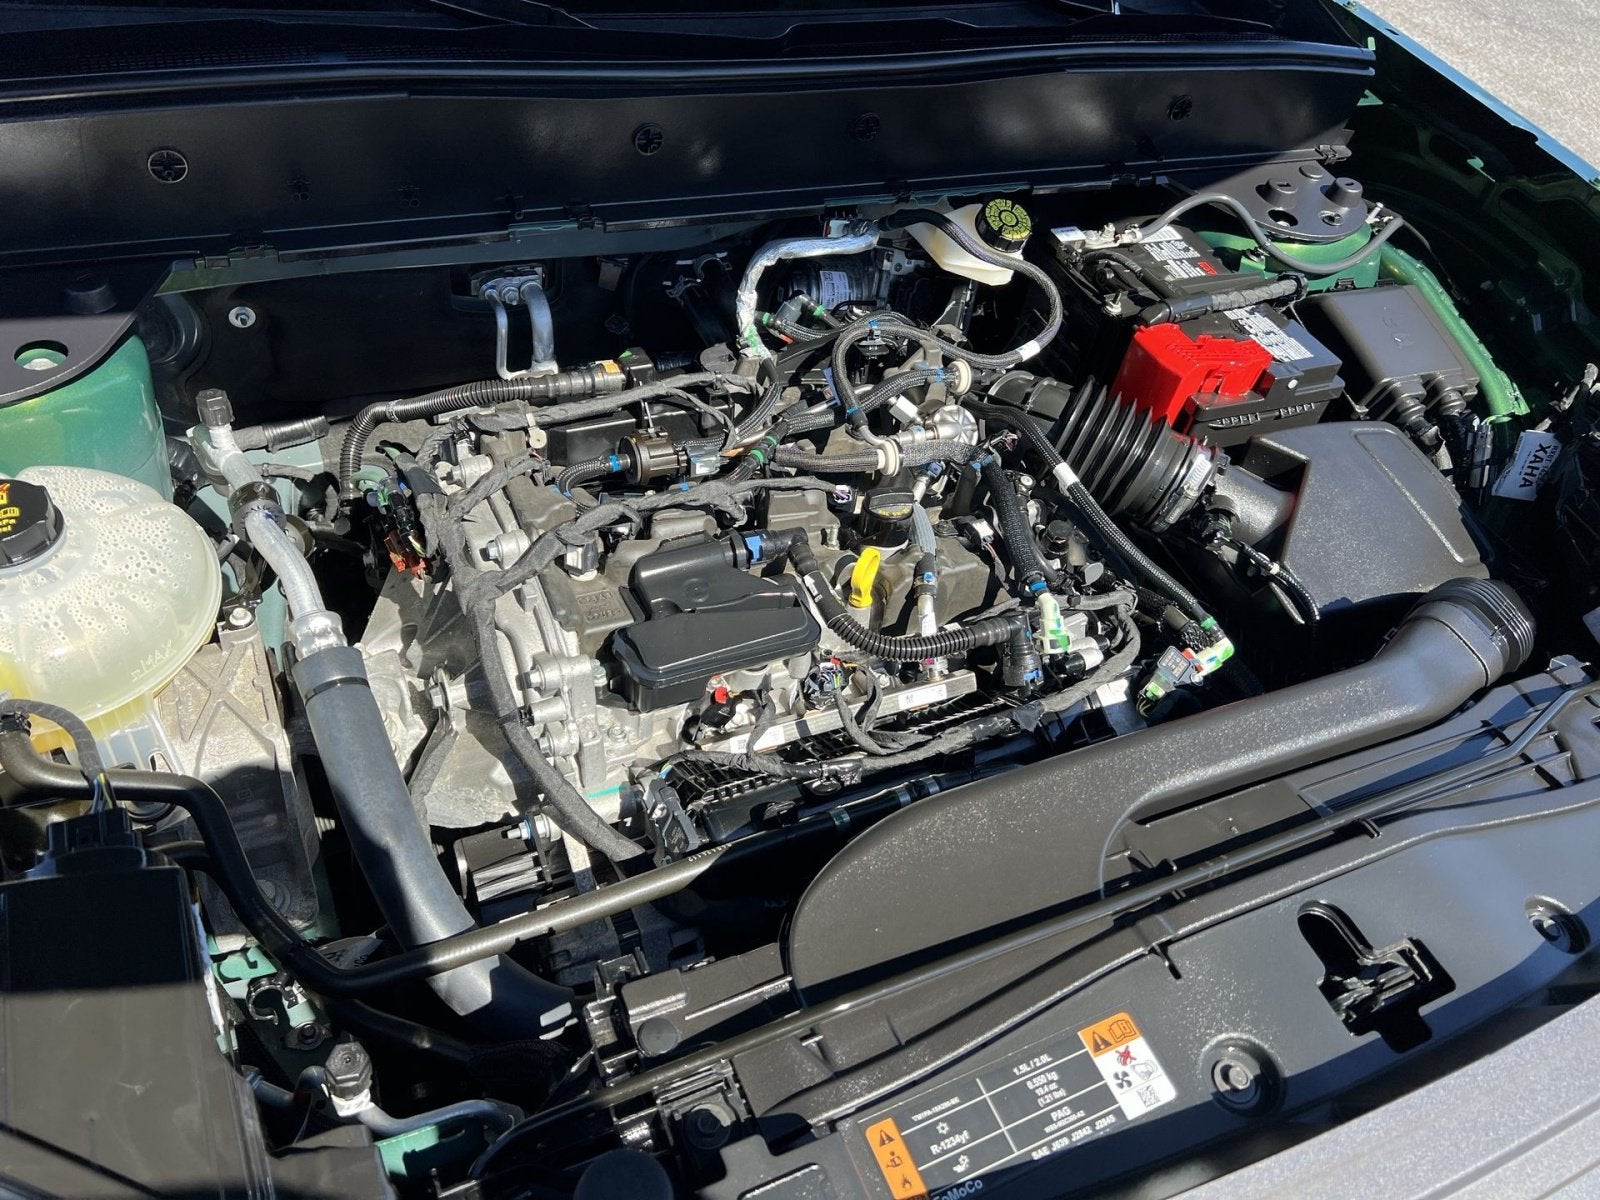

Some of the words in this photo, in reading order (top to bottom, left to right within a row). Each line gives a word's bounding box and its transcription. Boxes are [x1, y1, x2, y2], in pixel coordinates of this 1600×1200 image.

[1046, 1071, 1059, 1083] kg
[1050, 1105, 1072, 1122] PAG
[929, 1129, 970, 1155] R-1234yf
[1030, 1146, 1051, 1161] SAE
